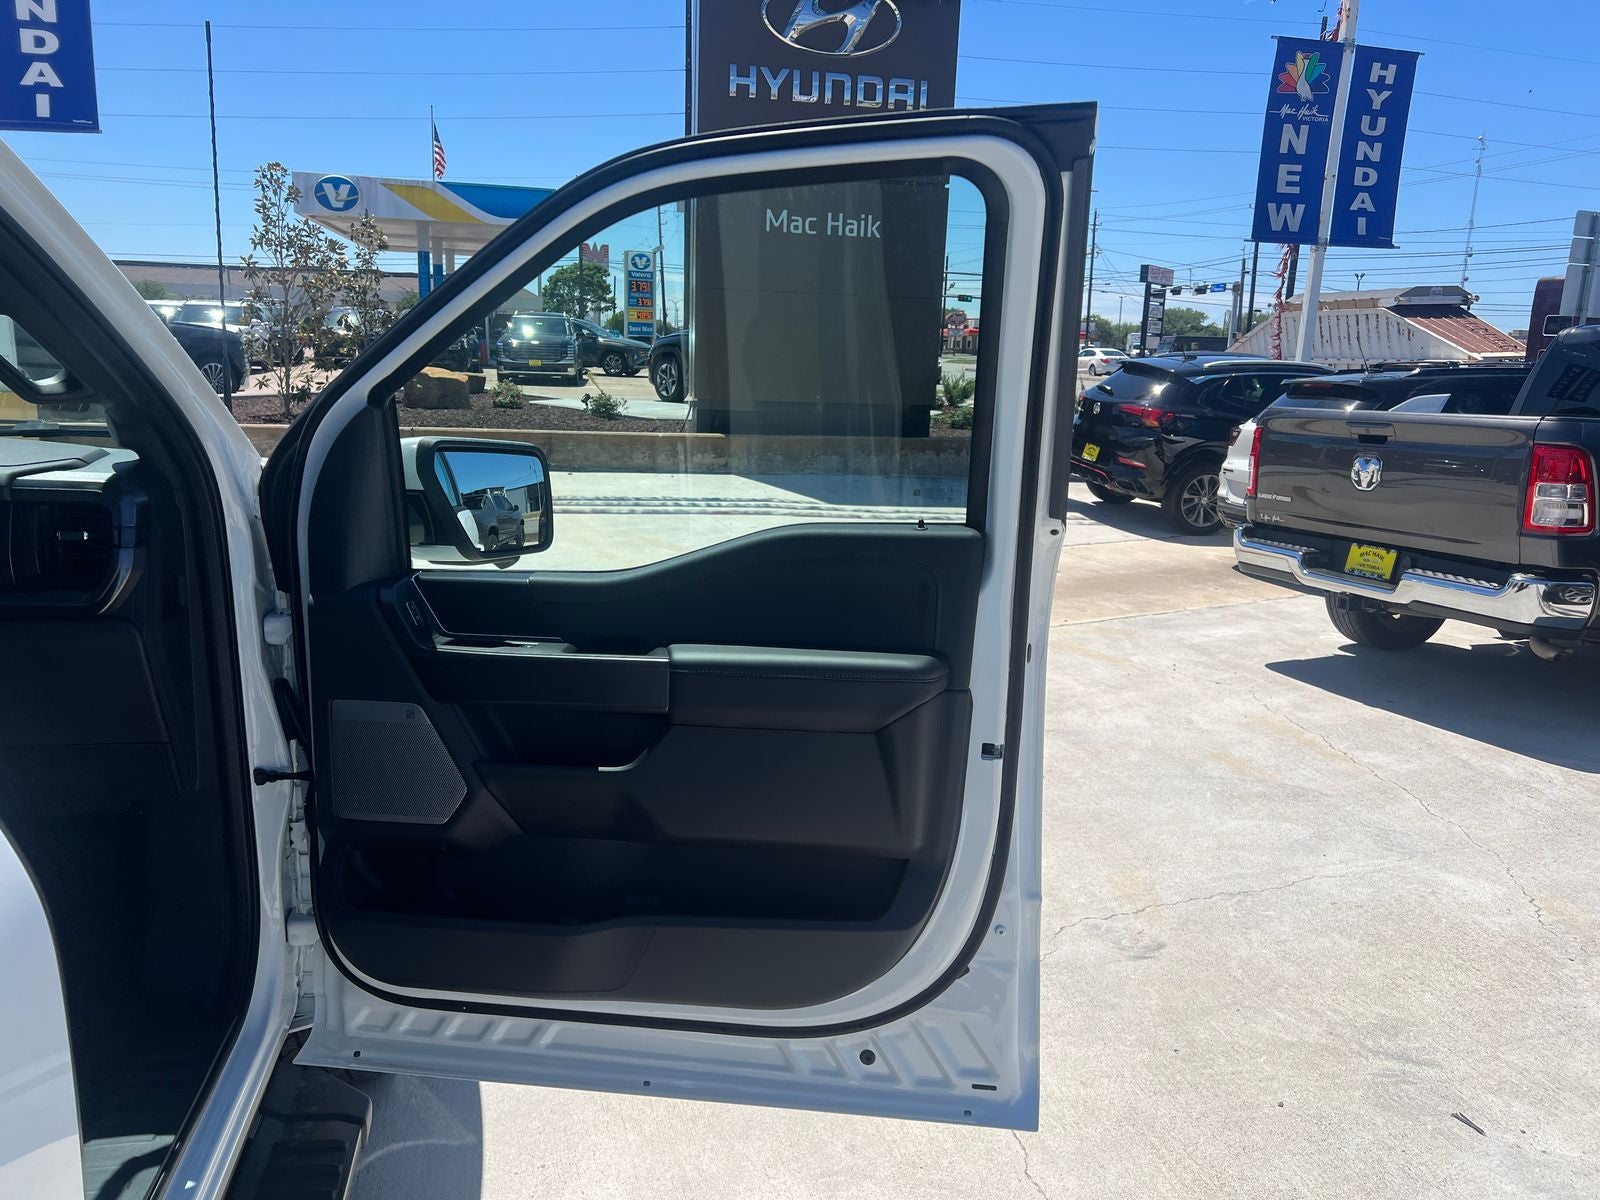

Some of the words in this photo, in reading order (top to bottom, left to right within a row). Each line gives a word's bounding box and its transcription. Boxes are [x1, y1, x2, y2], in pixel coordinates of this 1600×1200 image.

[729, 64, 928, 110] HYUNDAI
[1267, 123, 1310, 233] NEW
[1350, 62, 1397, 236] HYUNDAI
[765, 209, 817, 235] Mac
[826, 212, 882, 238] Haik
